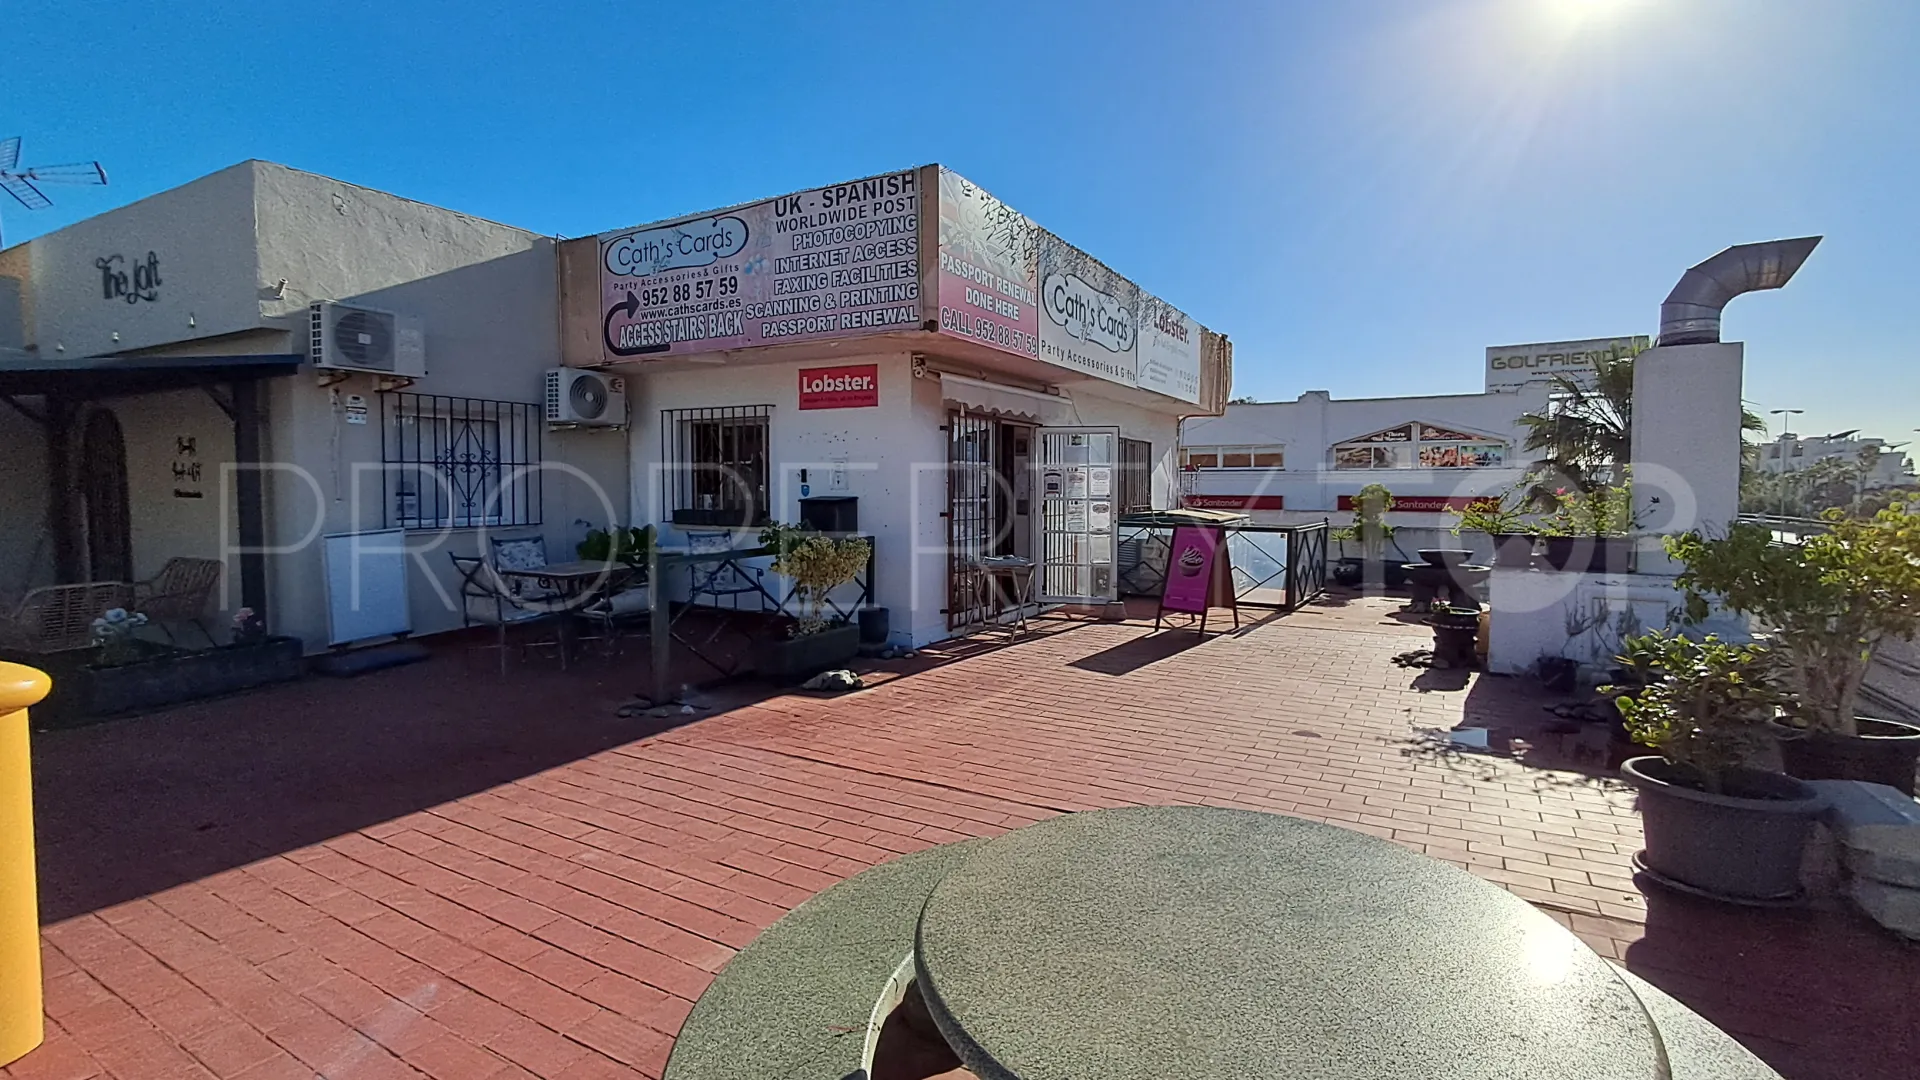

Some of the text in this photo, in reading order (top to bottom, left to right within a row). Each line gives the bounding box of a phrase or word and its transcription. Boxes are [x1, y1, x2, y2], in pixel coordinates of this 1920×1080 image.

[774, 195, 802, 217] UK
[822, 173, 915, 209] SPANISH
[776, 196, 916, 234] WORLDWIDE POST
[793, 214, 917, 250] PHOTOCOPYING
[618, 228, 732, 266] Cath's Cards
[775, 237, 918, 274] INTERNET ACCESS
[614, 264, 739, 291] Party Accessories & Gifts
[642, 276, 738, 307] 952 88 57 59
[774, 260, 918, 295] FAXING FACILITIES
[940, 252, 994, 289] PASSPORT
[996, 276, 1036, 307] RENEWAL
[640, 298, 741, 320] www.cathscards.es
[746, 282, 918, 320] SCANNING & PRINTING
[966, 287, 1019, 321] DONE HERE
[1054, 284, 1128, 342] Cath's Cards
[620, 310, 744, 348] ACCESS STAIRS BACK
[762, 306, 919, 338] PASSPORT RENEWAL
[941, 306, 1037, 354] CALL 952 88 57 59
[1153, 305, 1190, 345] Lobster.
[1041, 339, 1064, 361] Party
[1066, 350, 1114, 374] Accessories
[1114, 365, 1119, 376] &
[1120, 366, 1136, 382] Gifts
[802, 374, 874, 393] Lobster.
